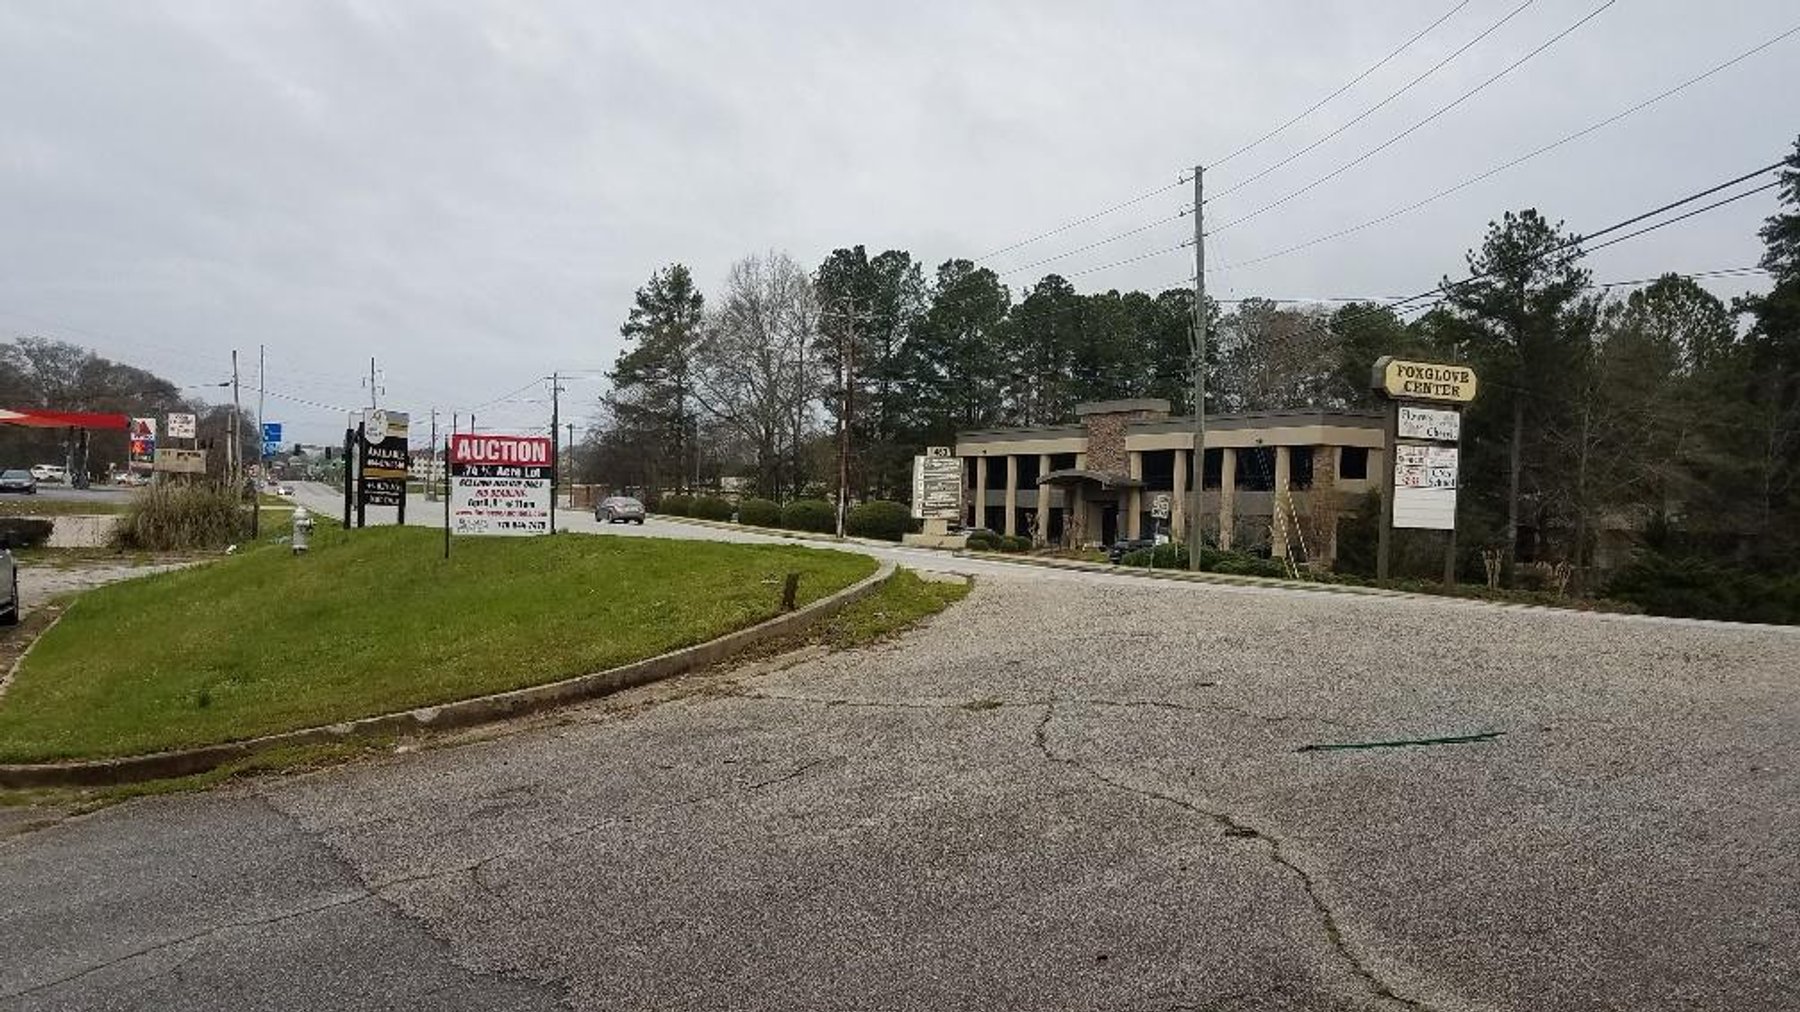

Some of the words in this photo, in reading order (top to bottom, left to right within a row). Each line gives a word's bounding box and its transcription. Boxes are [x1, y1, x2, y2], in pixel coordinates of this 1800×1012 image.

[1397, 365, 1469, 383] FOXGLOVE
[1404, 381, 1460, 397] CENTER
[457, 439, 546, 462] AUCTION
[496, 466, 521, 477] Acre
[525, 467, 541, 478] Lot
